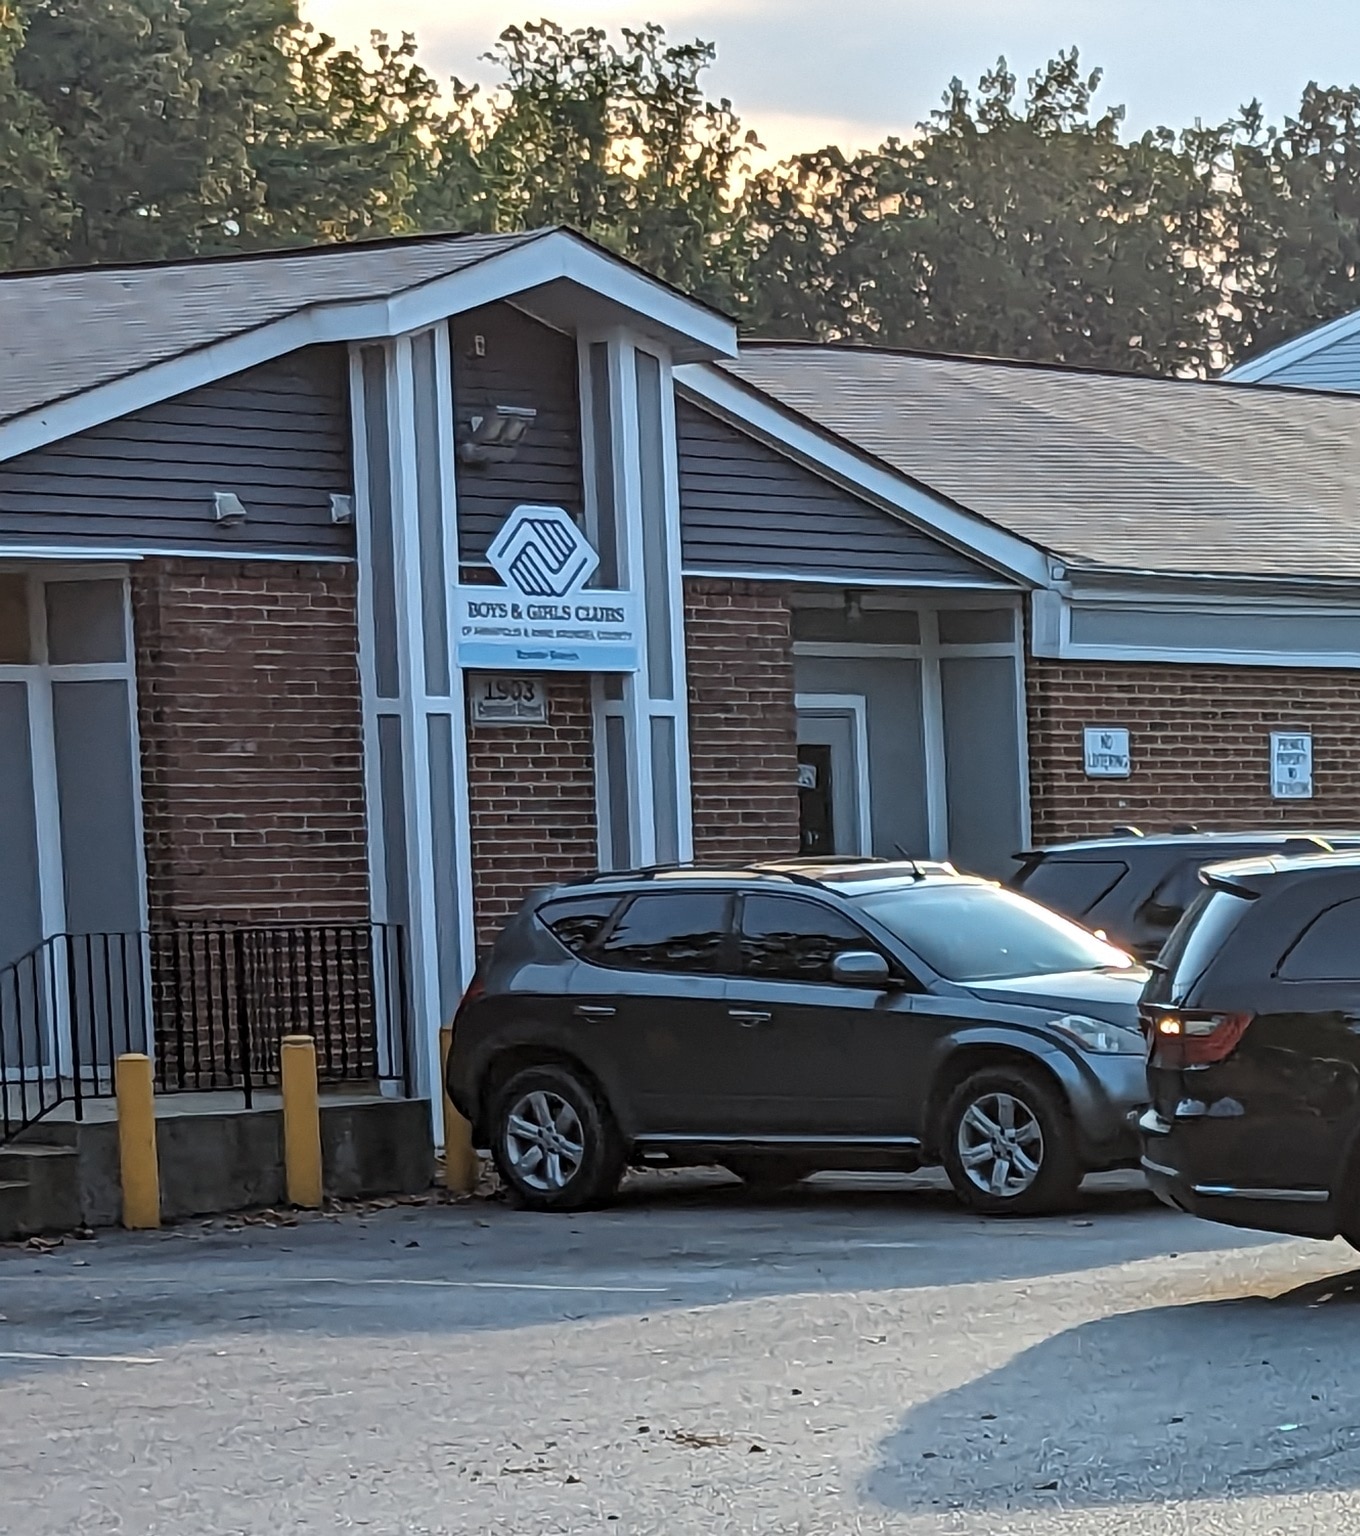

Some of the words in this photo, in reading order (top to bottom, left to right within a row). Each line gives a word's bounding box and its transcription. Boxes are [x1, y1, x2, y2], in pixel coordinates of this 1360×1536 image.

[467, 602, 508, 618] BOYS
[527, 604, 571, 621] GIRLS
[575, 606, 625, 622] CLUBS
